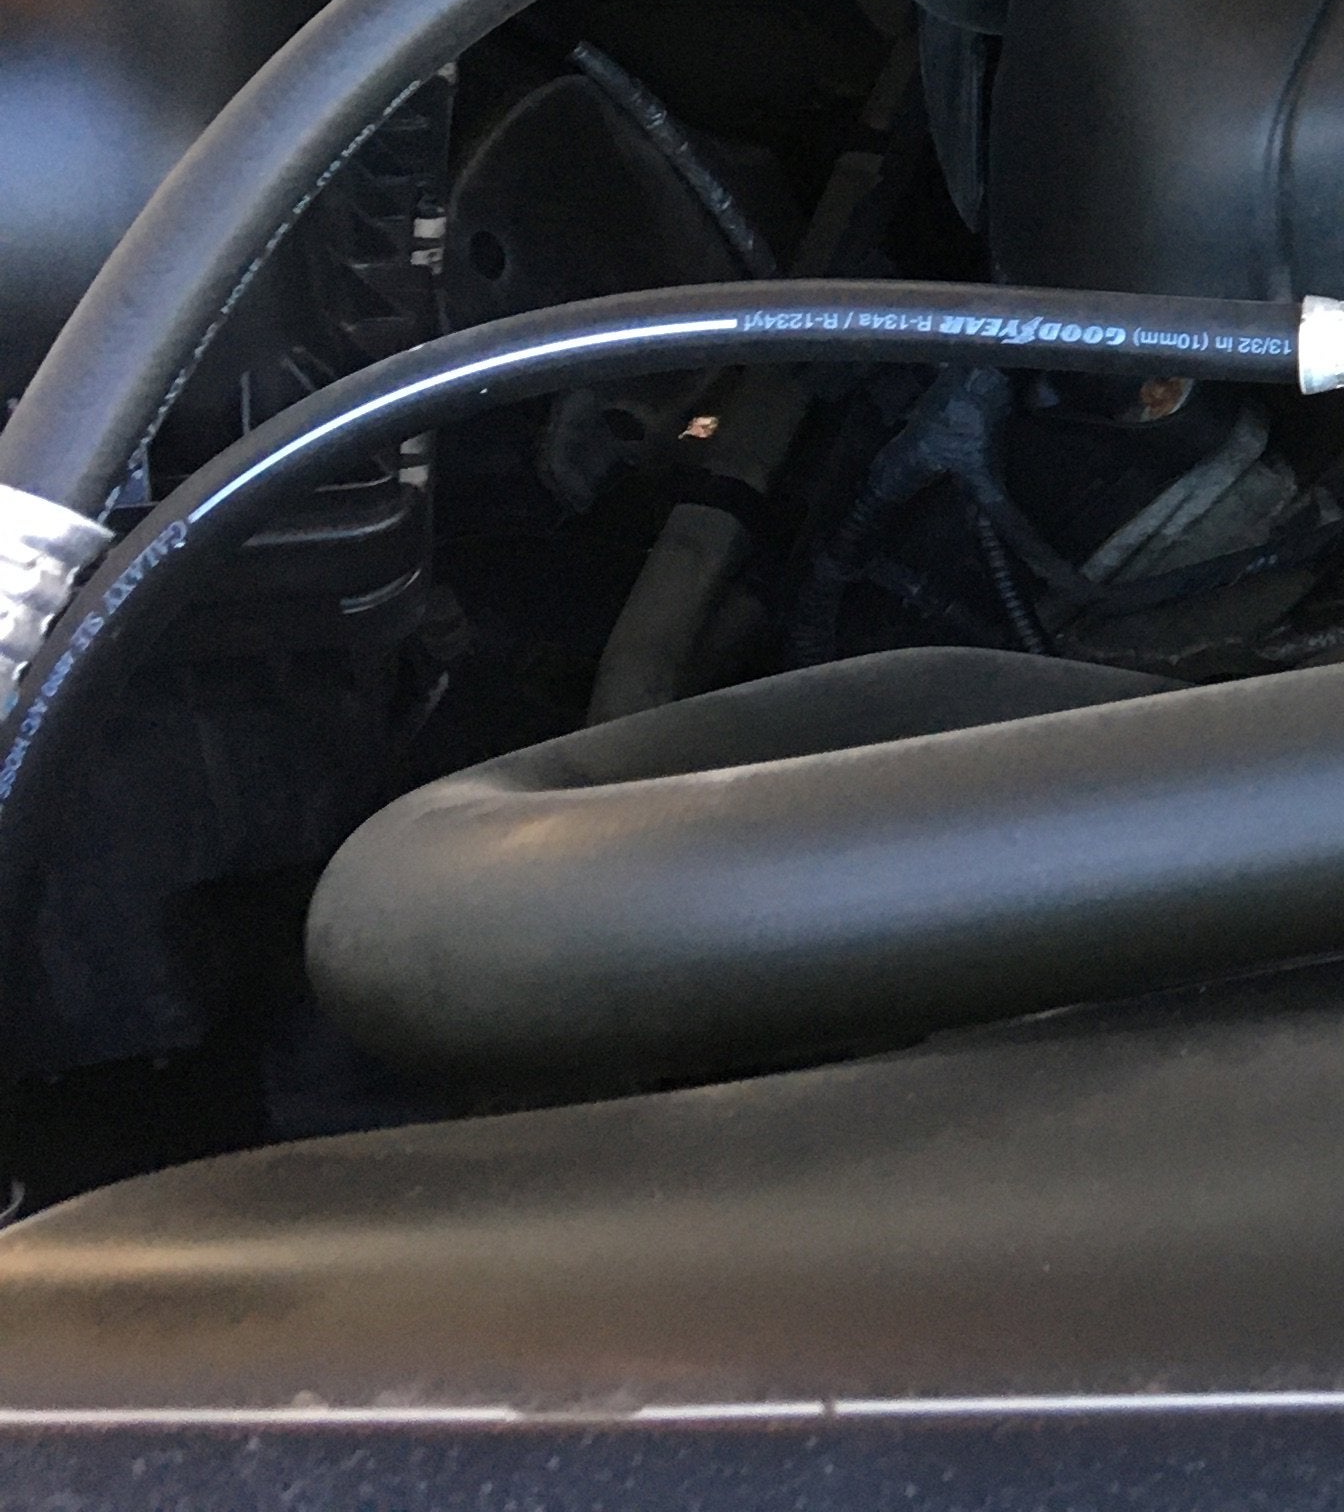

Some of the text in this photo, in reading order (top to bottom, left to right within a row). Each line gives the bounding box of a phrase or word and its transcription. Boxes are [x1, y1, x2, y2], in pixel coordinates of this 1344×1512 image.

[743, 310, 1293, 355] 13/32 in (10mm) GOODYEAR R-134a / R-1234yf
